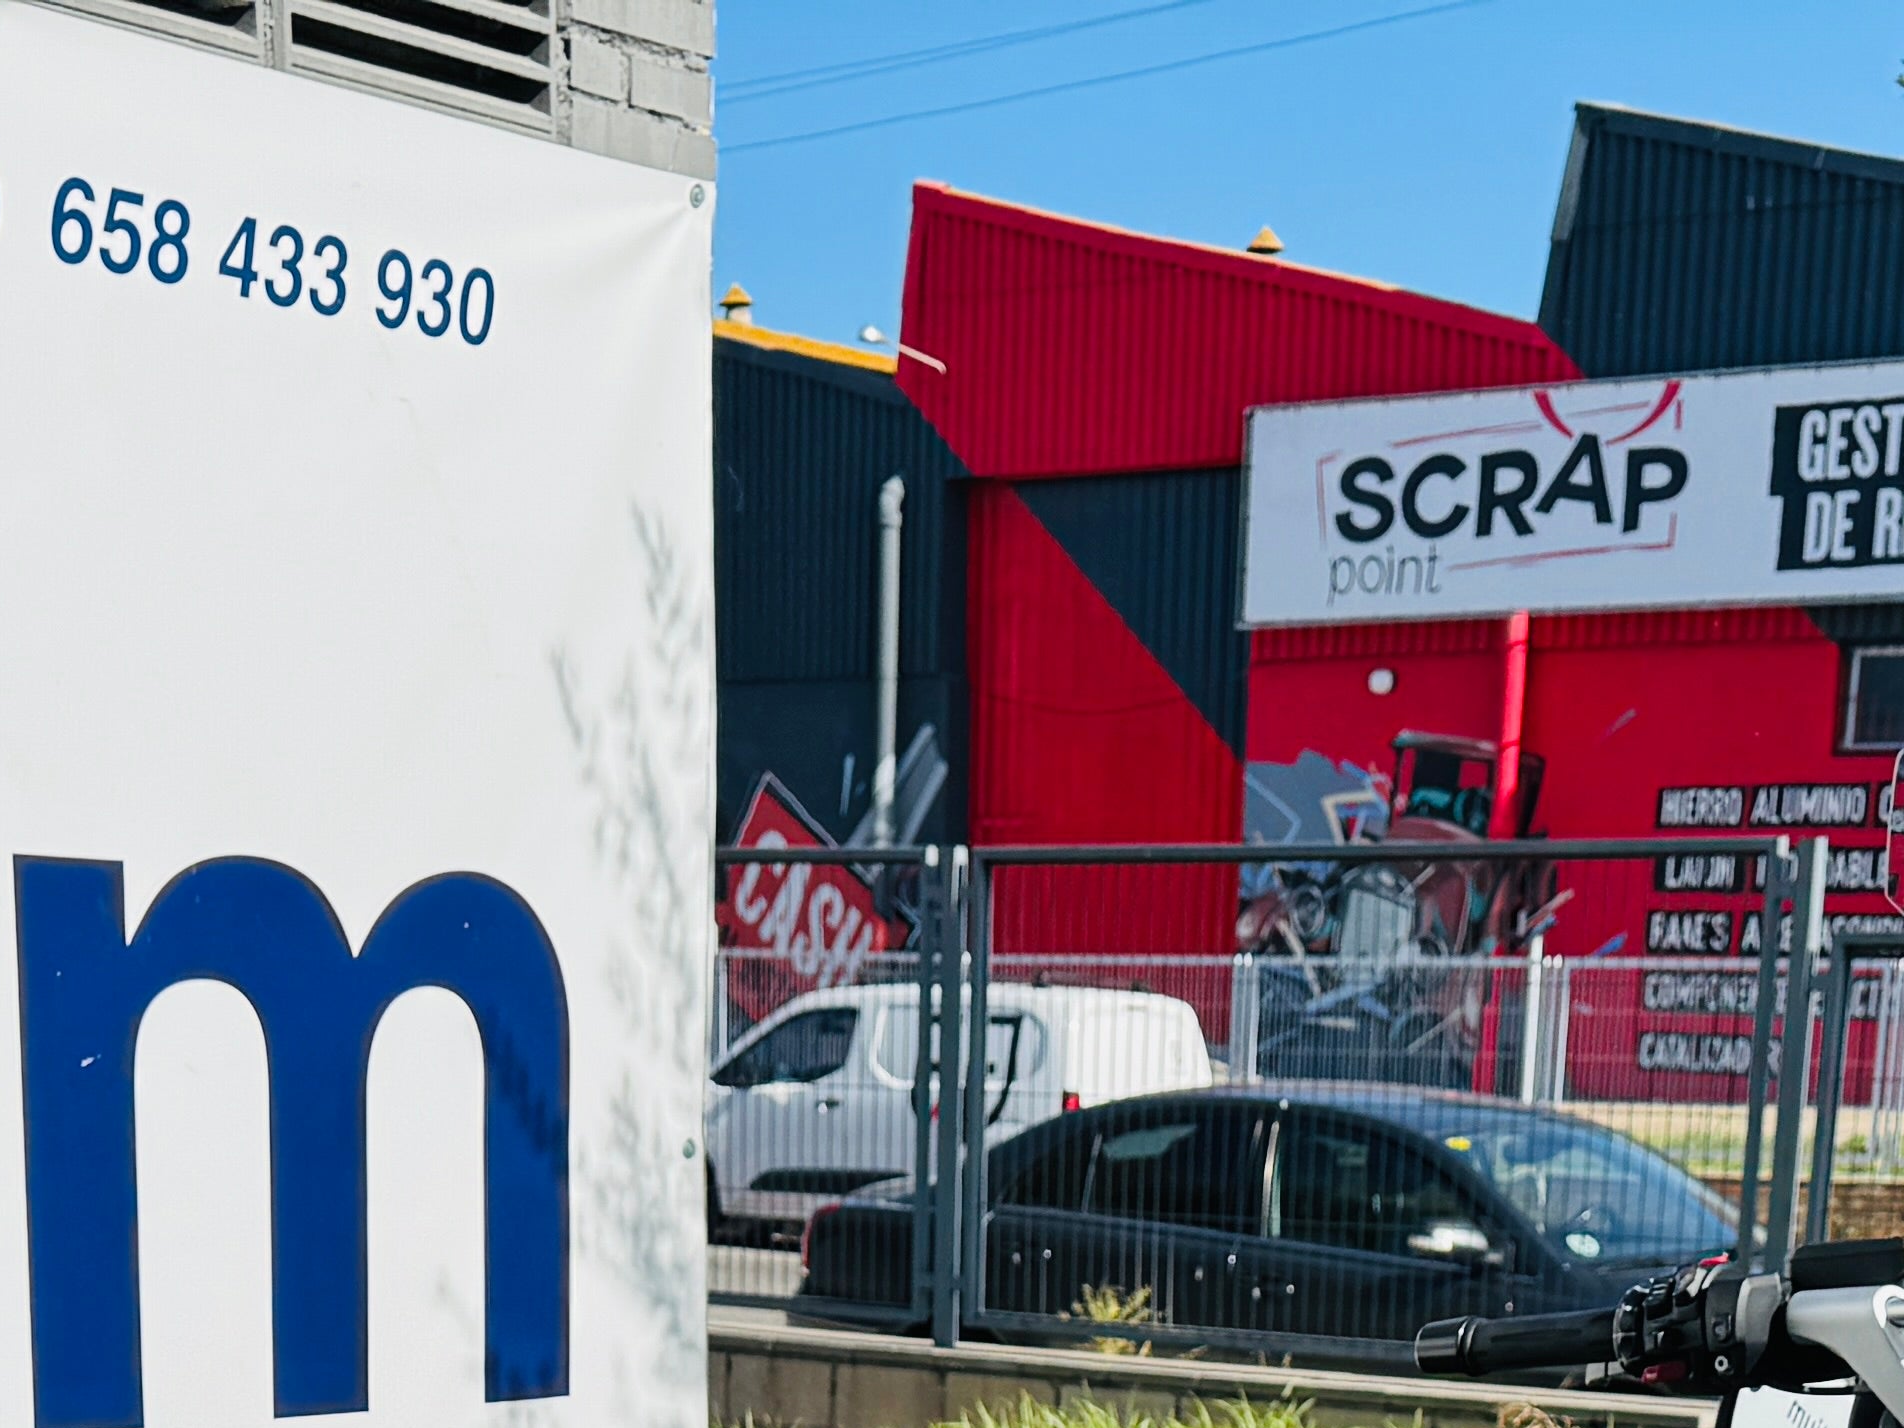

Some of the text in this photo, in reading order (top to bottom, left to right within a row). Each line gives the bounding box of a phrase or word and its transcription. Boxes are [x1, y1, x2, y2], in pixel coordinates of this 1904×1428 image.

[50, 176, 496, 347] 658 433 930
[1334, 432, 1689, 543] SCRAP
[1803, 492, 1859, 562] DE
[1326, 543, 1442, 606] point
[1749, 784, 1867, 824] ALUMINIO
